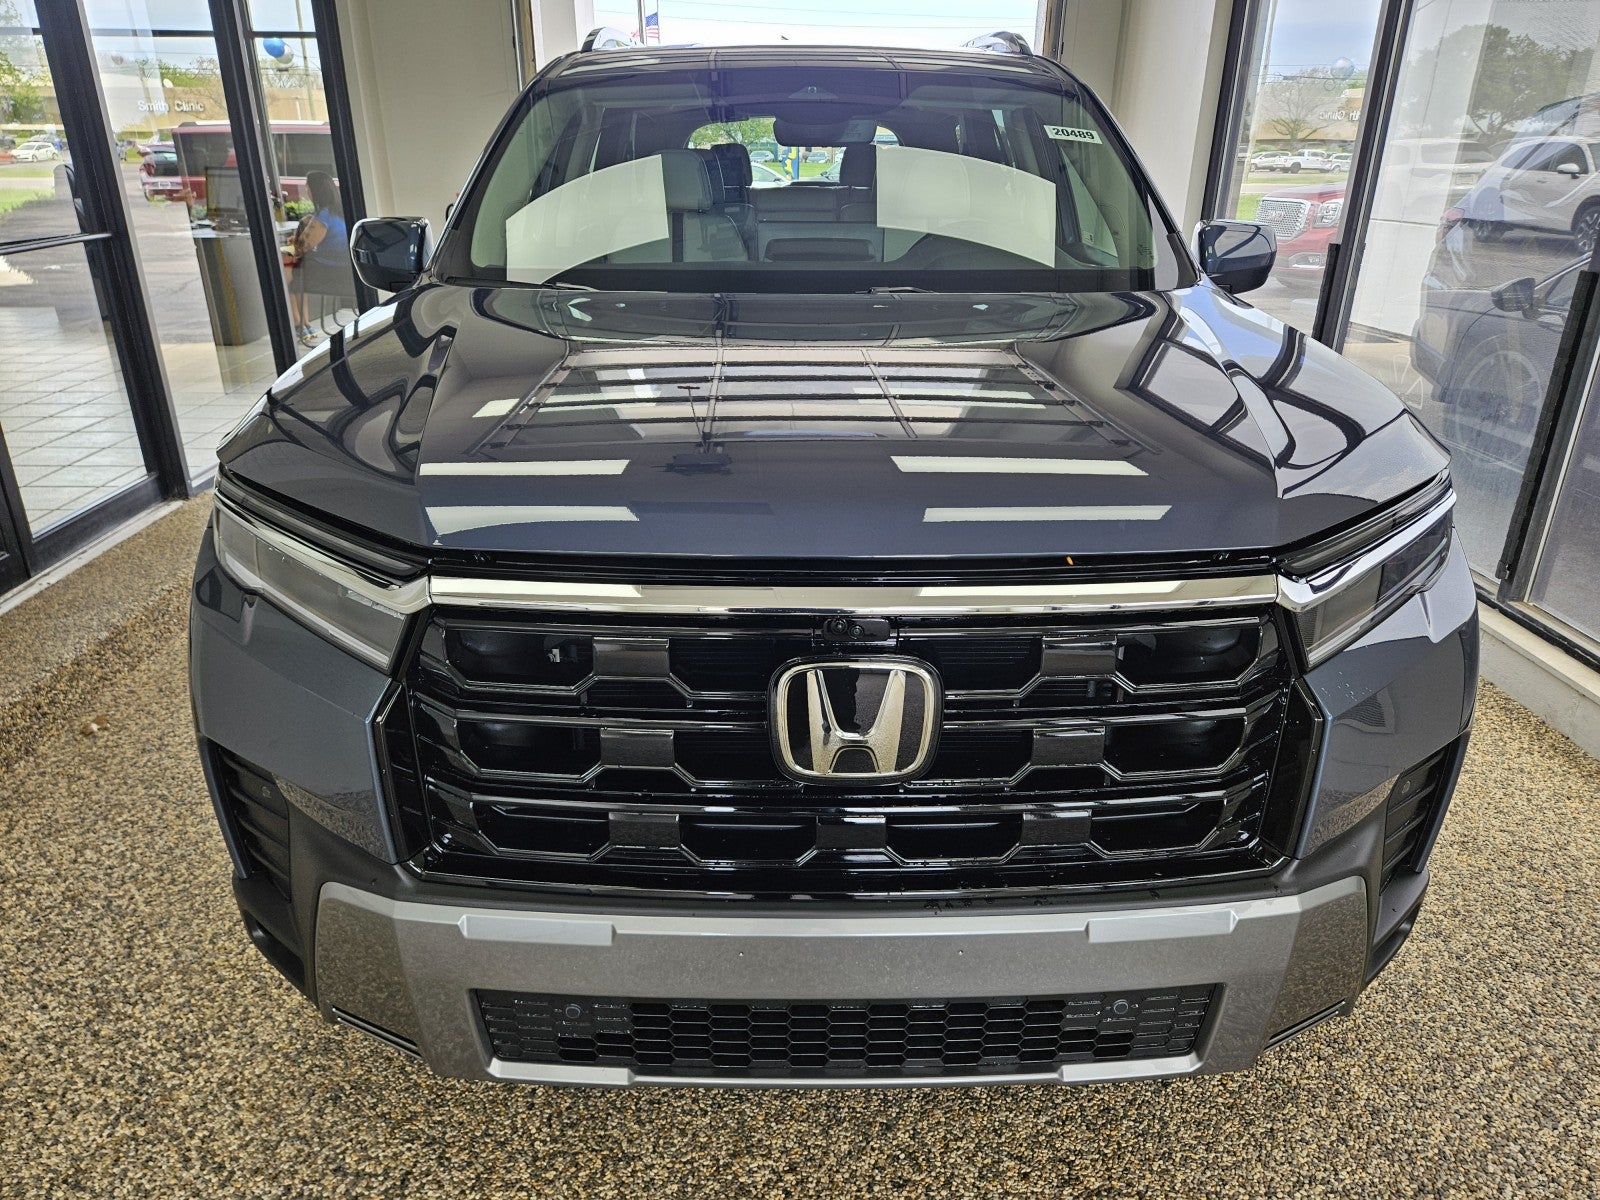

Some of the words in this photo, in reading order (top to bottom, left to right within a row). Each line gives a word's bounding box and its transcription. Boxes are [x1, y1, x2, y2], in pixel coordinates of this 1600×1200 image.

[137, 100, 170, 112] Smith
[174, 100, 205, 112] Clinic
[1052, 127, 1095, 140] 20489
